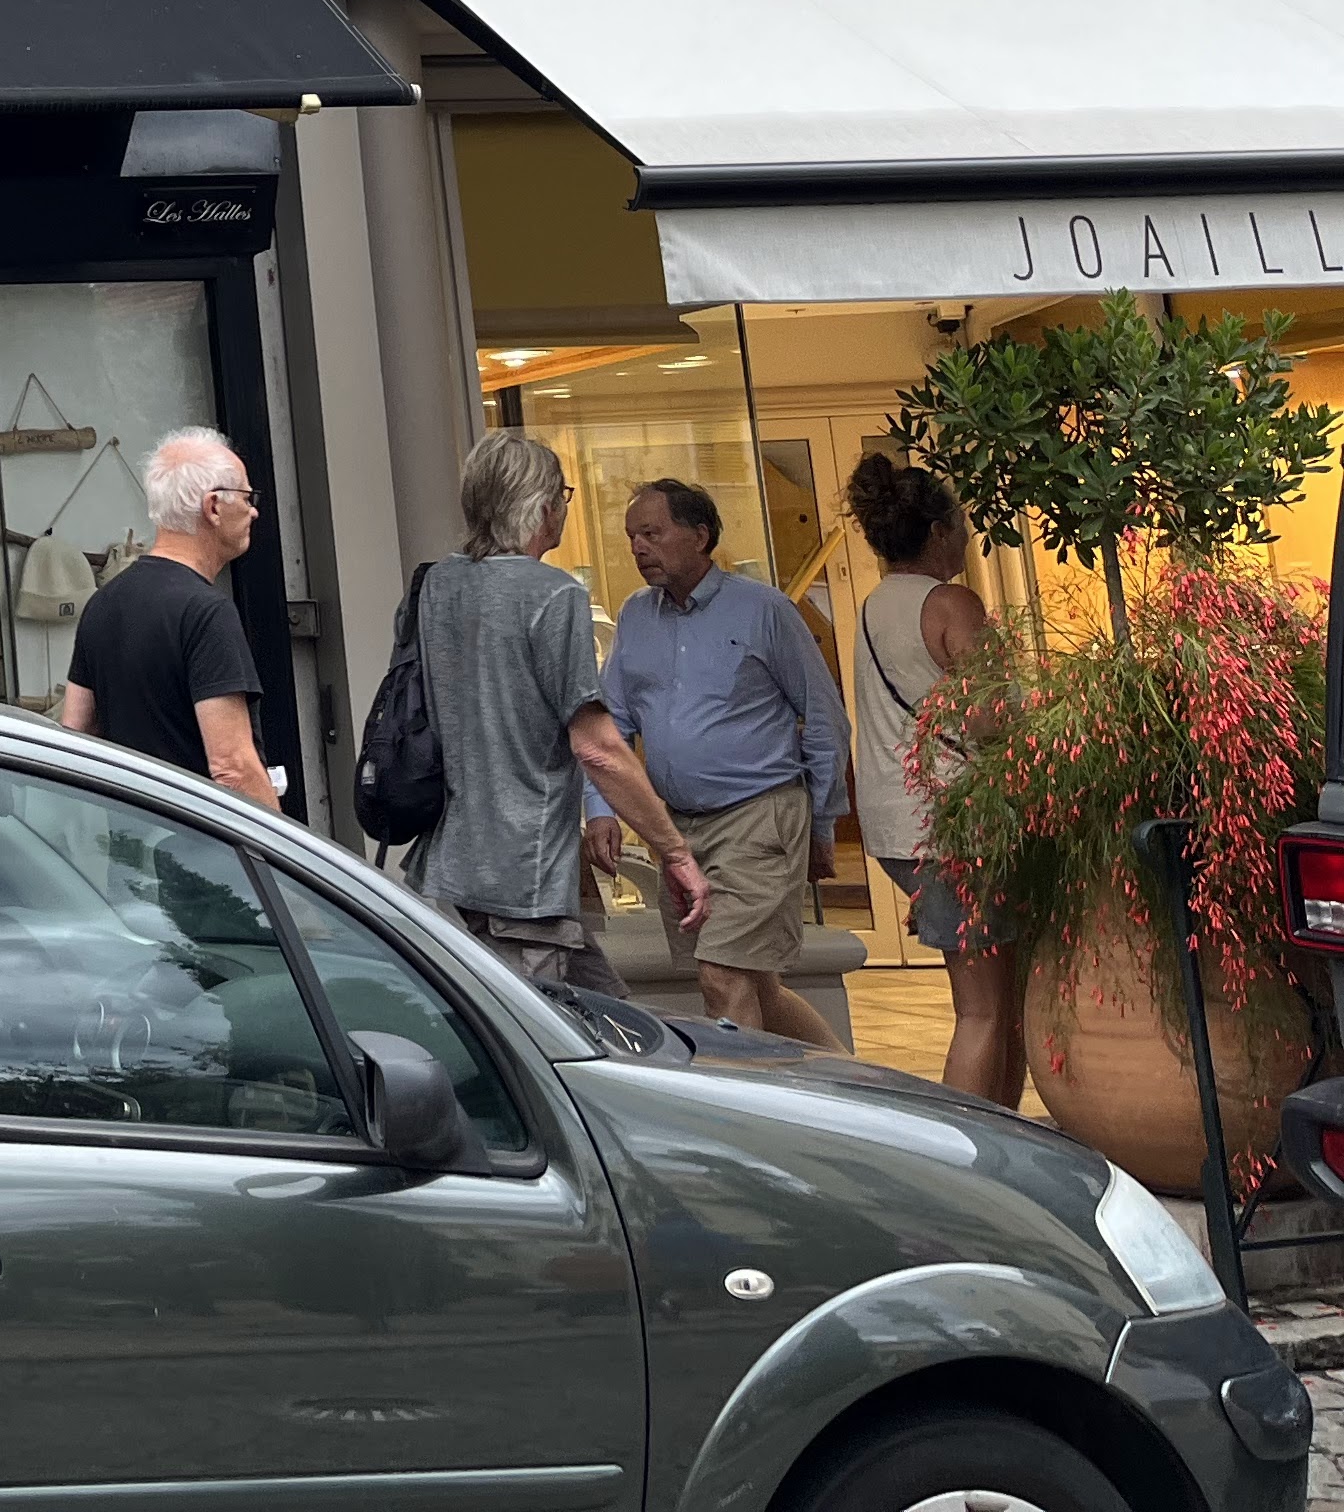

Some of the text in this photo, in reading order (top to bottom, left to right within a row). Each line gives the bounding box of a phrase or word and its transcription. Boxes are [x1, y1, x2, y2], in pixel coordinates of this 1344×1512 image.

[142, 199, 253, 224] Les Halles
[1013, 209, 1344, 281] JOAILL
